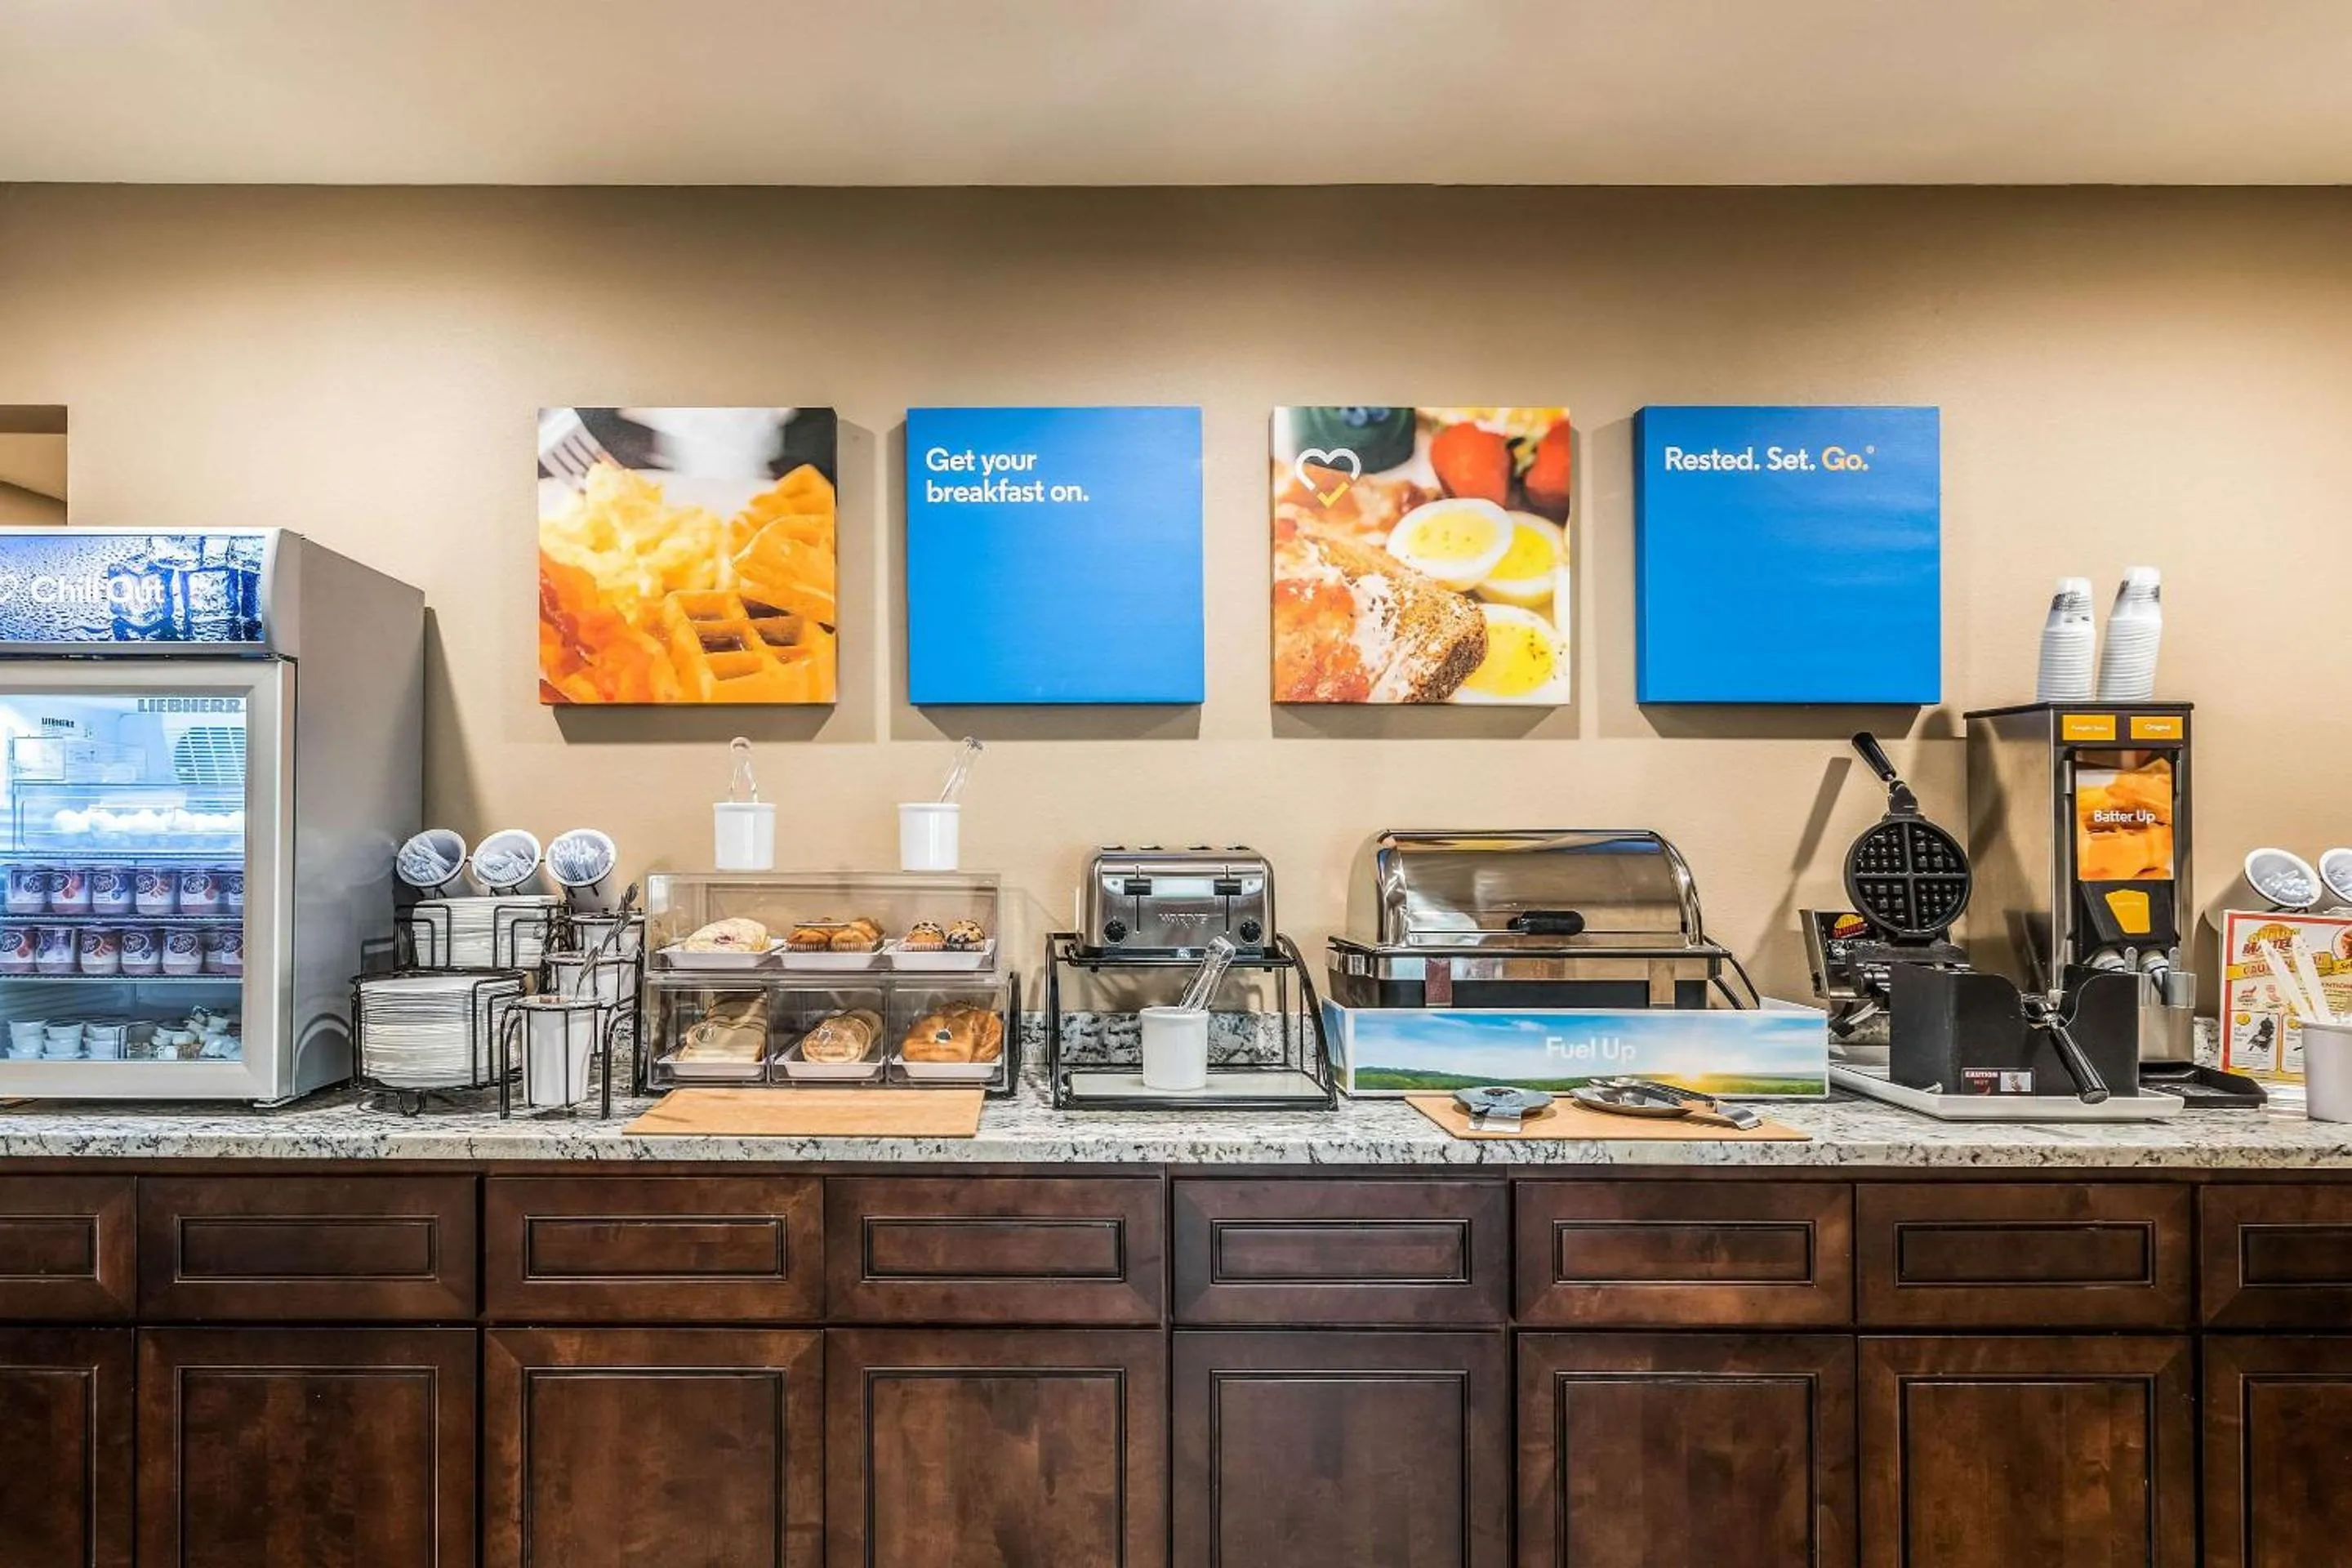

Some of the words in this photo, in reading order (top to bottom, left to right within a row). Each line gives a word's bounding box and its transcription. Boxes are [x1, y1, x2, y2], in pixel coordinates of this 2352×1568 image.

[925, 447, 975, 472] Get
[982, 453, 1037, 476] your
[1664, 446, 1761, 471] Rested.
[1766, 446, 1816, 471] Set.
[926, 479, 1045, 503] breakfast
[1050, 484, 1089, 503] on.
[31, 573, 101, 604] Chill
[108, 573, 166, 604] Out
[137, 698, 242, 713] LIEBHERR
[2094, 809, 2134, 823] Batter
[2136, 808, 2156, 825] Up
[1546, 1036, 1597, 1059] Fuel
[1602, 1036, 1637, 1066] Up
[1965, 1070, 1999, 1078] CAUTION
